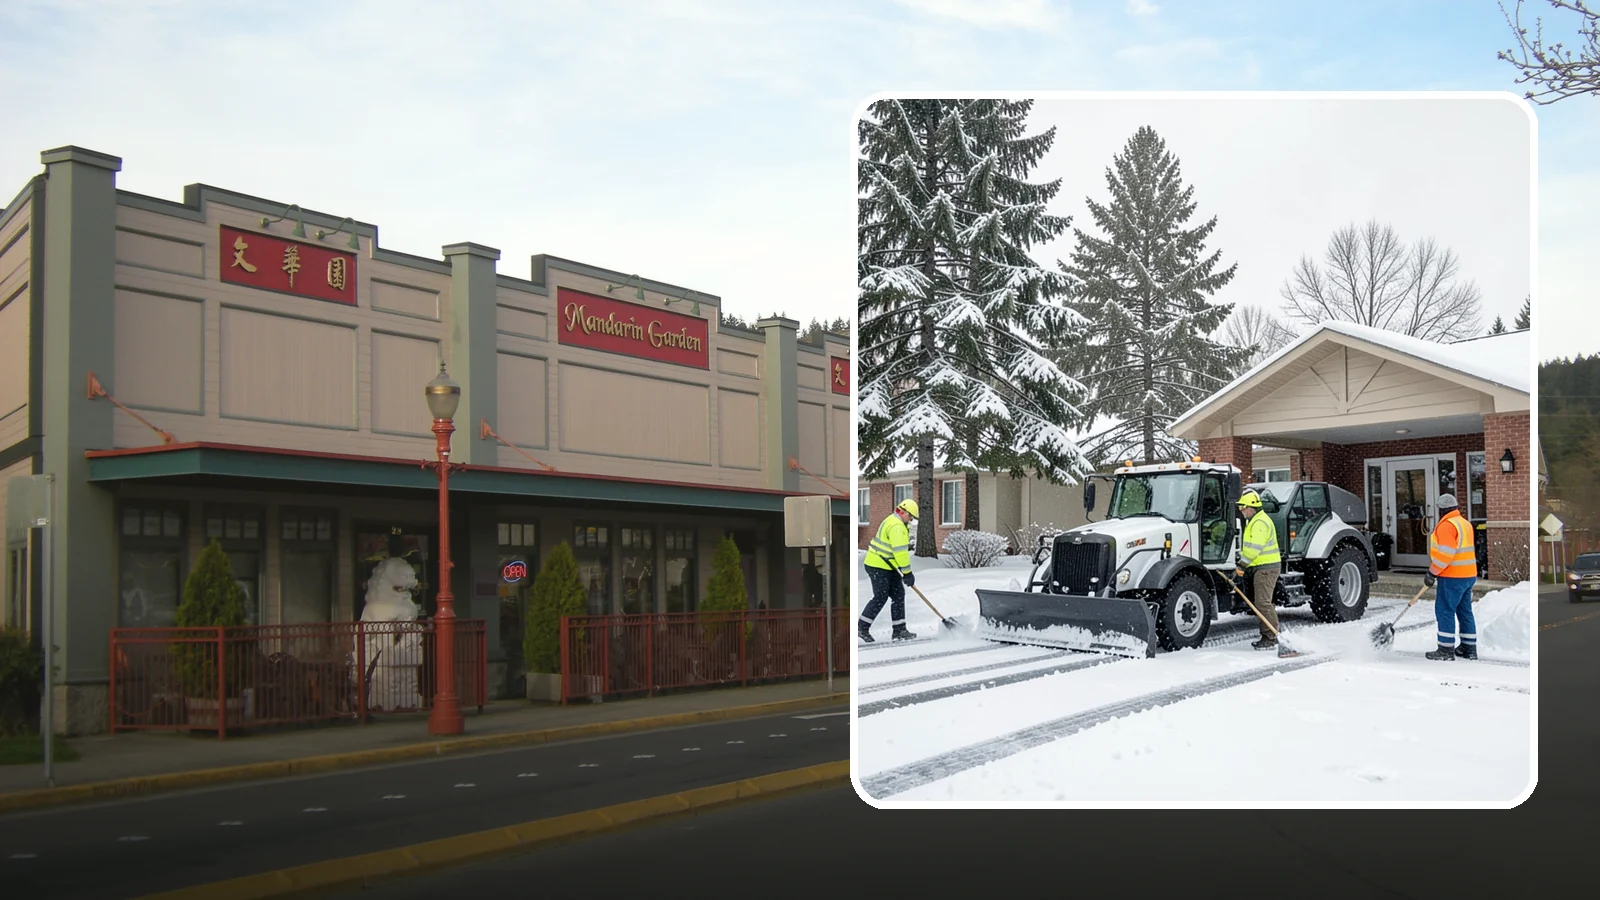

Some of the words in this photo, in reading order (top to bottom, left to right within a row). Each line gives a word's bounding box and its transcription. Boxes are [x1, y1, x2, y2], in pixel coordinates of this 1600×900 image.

[230, 235, 347, 291] 文華園
[564, 302, 645, 341] Mandarin
[647, 320, 702, 352] Garden
[503, 565, 527, 578] OPEN
